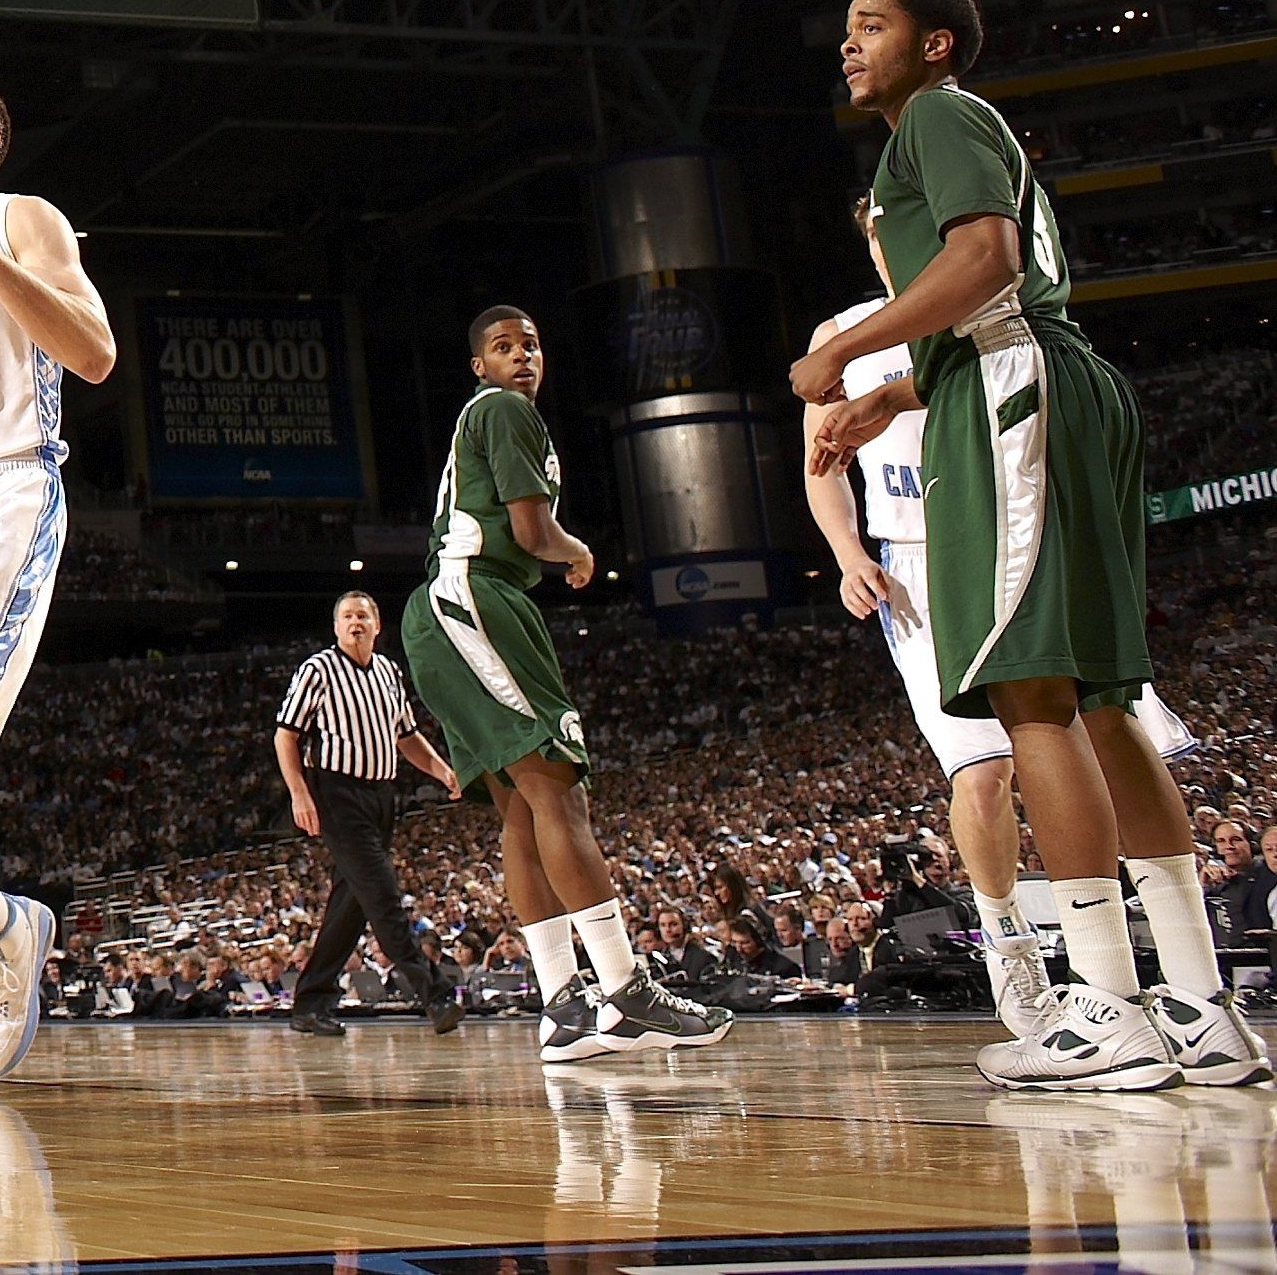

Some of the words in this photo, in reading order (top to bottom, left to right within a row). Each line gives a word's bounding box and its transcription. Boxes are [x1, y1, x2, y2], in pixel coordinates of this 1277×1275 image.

[157, 318, 219, 338] THERE
[226, 319, 264, 338] ARE
[271, 320, 323, 339] OVER
[157, 338, 328, 382] 400,000
[160, 381, 198, 396] NCAA
[163, 397, 199, 412] AND
[204, 397, 252, 413] MOST
[258, 397, 280, 413] OF
[285, 397, 330, 413] THEM
[165, 428, 218, 444] OTHER
[222, 428, 266, 444] THAN
[271, 429, 338, 445] SPORTS.
